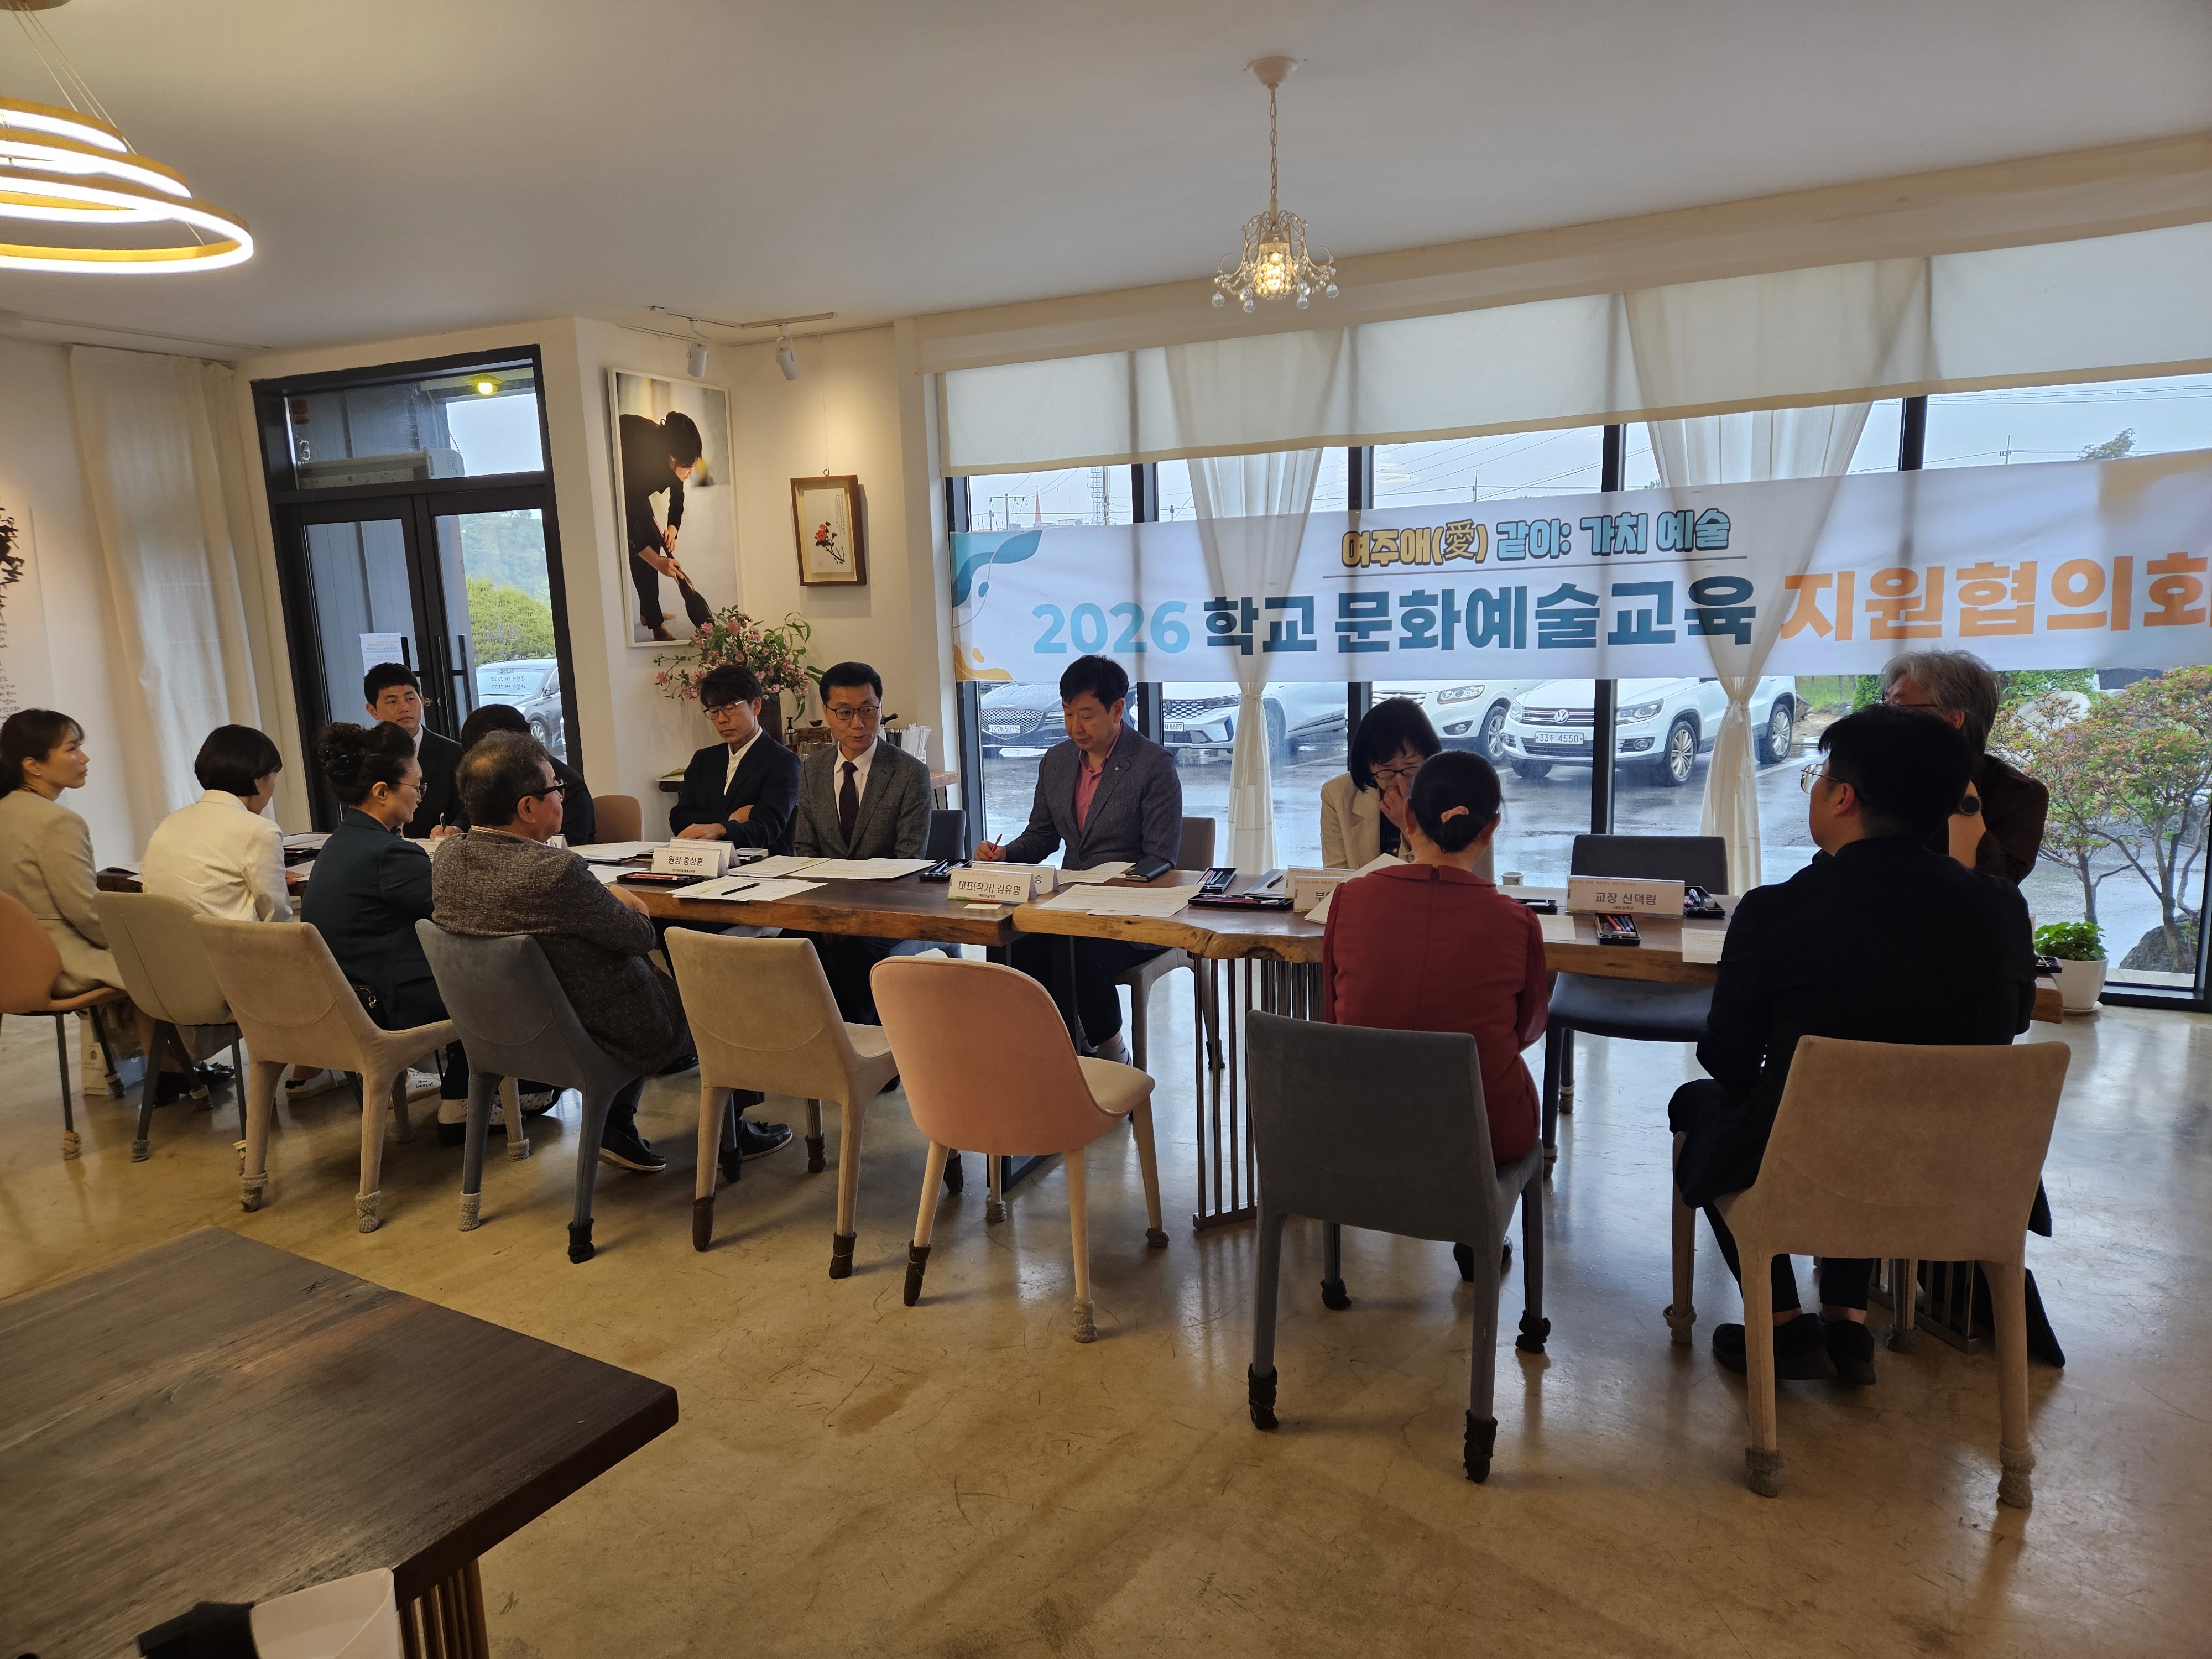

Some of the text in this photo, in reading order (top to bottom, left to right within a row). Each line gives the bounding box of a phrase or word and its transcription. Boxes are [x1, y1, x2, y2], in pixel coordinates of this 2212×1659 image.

[1342, 508, 1731, 568] 여주애(愛) 같이: 가치 예술
[1032, 551, 2212, 655] 2026 학교 문화예술교육 지원협의회
[1540, 734, 1579, 743] 33주 4550
[668, 855, 703, 866] 원장 홍성훈
[997, 884, 1021, 896] 김유영
[1316, 891, 1331, 902] 부
[1595, 892, 1656, 905] 교장 신덕림
